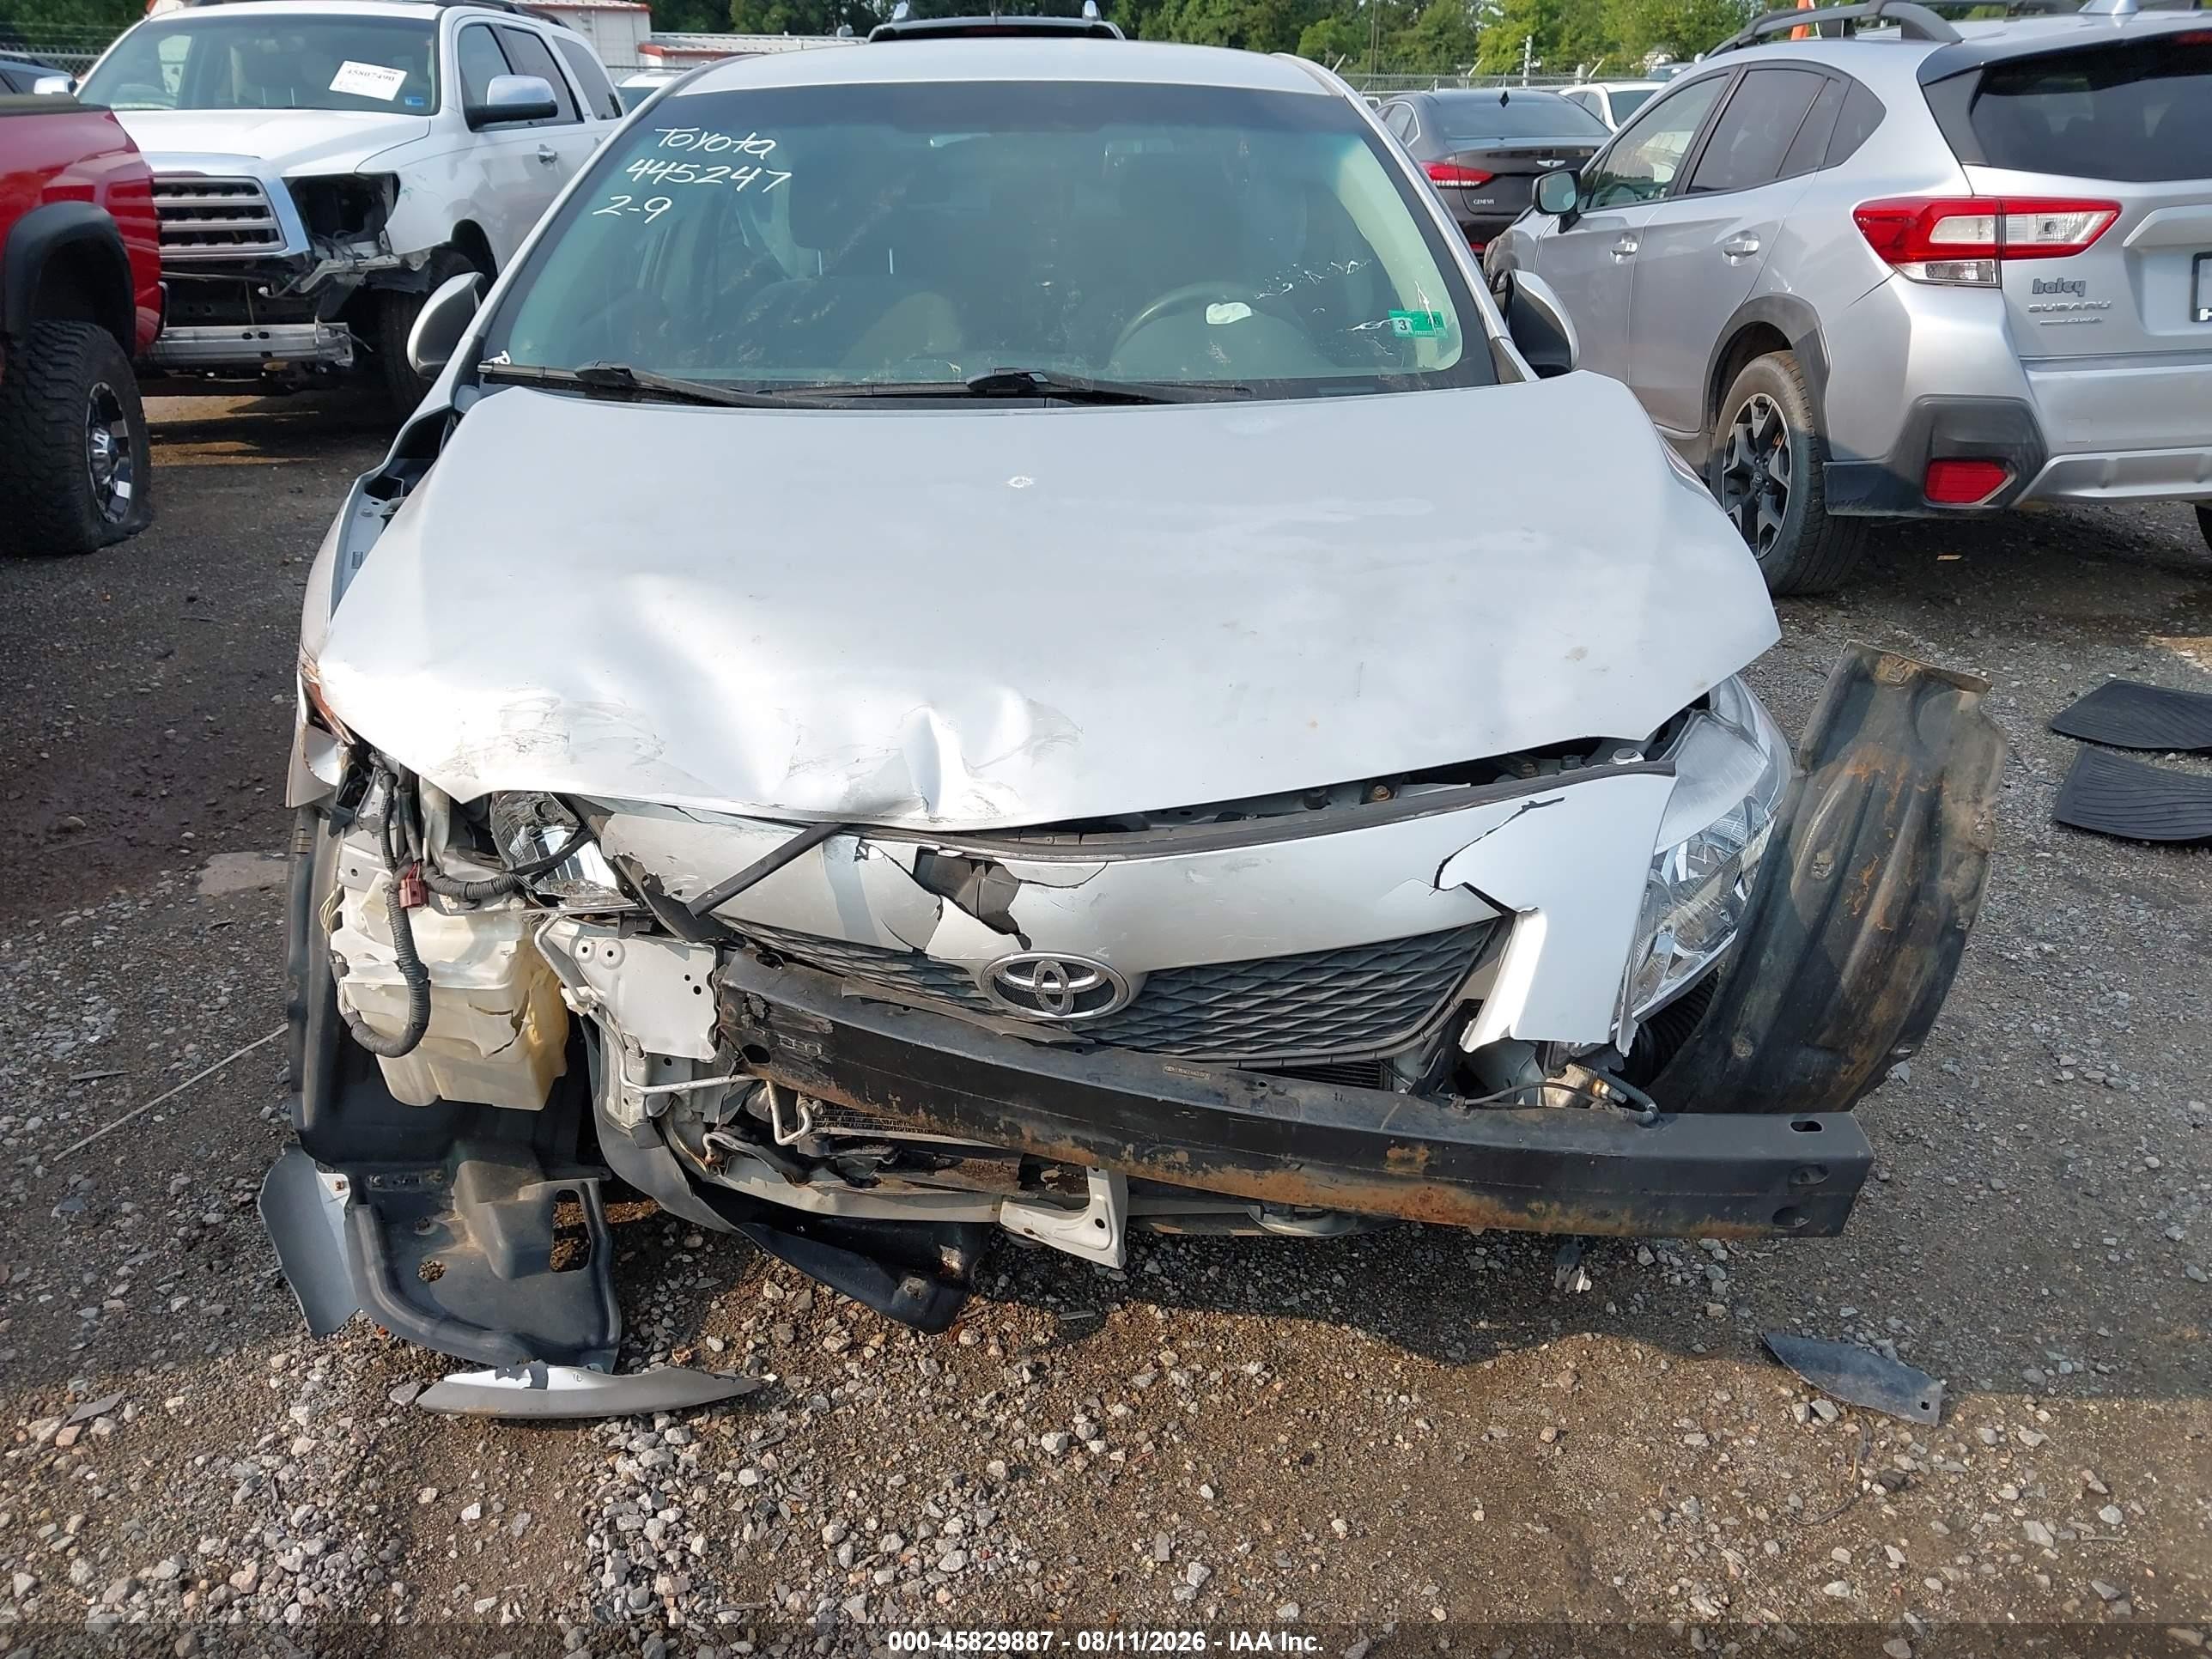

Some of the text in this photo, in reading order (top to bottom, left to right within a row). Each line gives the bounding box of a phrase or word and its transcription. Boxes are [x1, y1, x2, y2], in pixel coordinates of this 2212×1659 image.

[625, 158, 793, 193] 445247
[592, 195, 673, 224] 2-9
[2032, 277, 2086, 296] haley
[2028, 301, 2112, 313] SUBARU
[1398, 319, 1408, 331] 3
